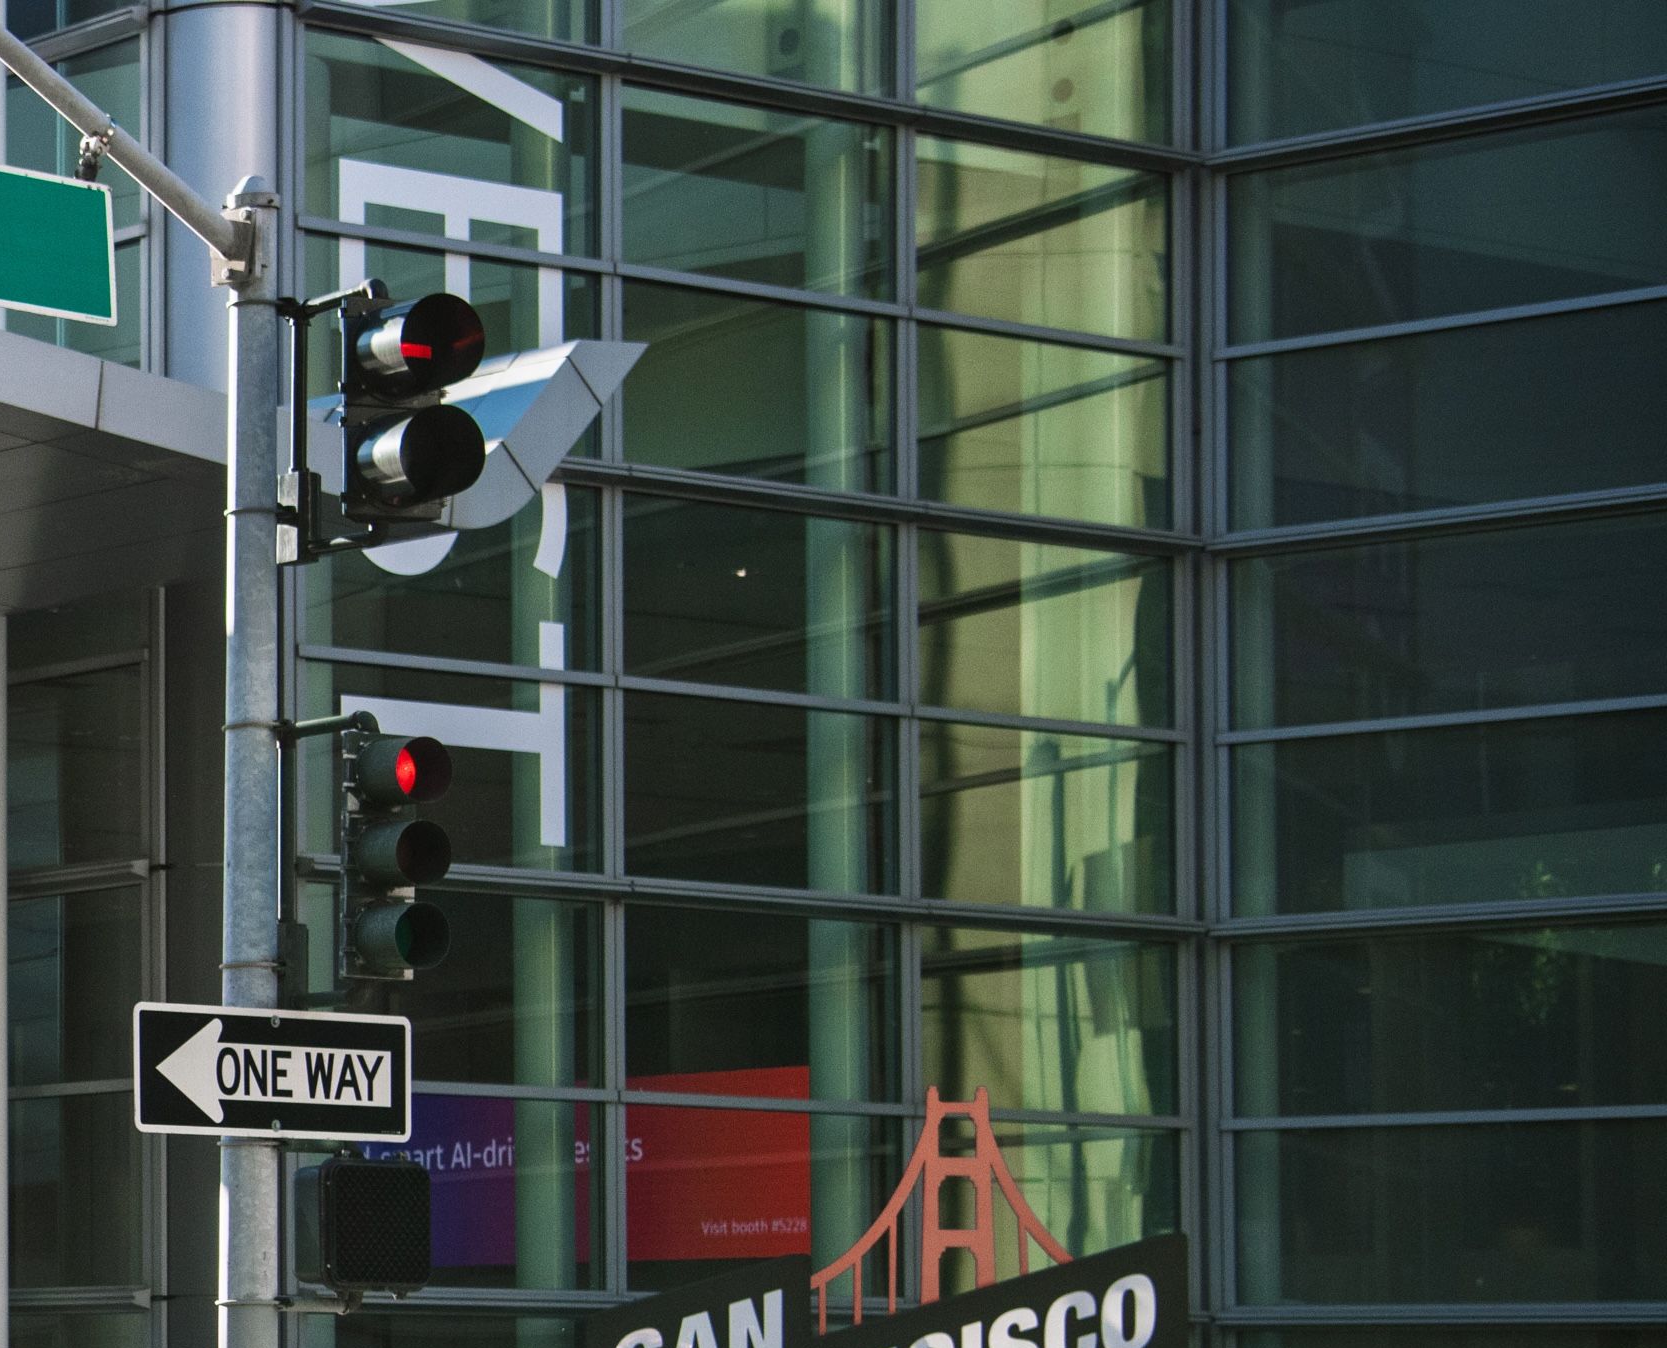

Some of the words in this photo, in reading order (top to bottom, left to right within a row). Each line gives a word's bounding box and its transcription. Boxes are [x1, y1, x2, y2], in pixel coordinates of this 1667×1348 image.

[216, 1046, 293, 1099] ONE
[305, 1051, 385, 1103] WAY
[701, 1220, 727, 1235] Visit
[731, 1218, 768, 1234] booth
